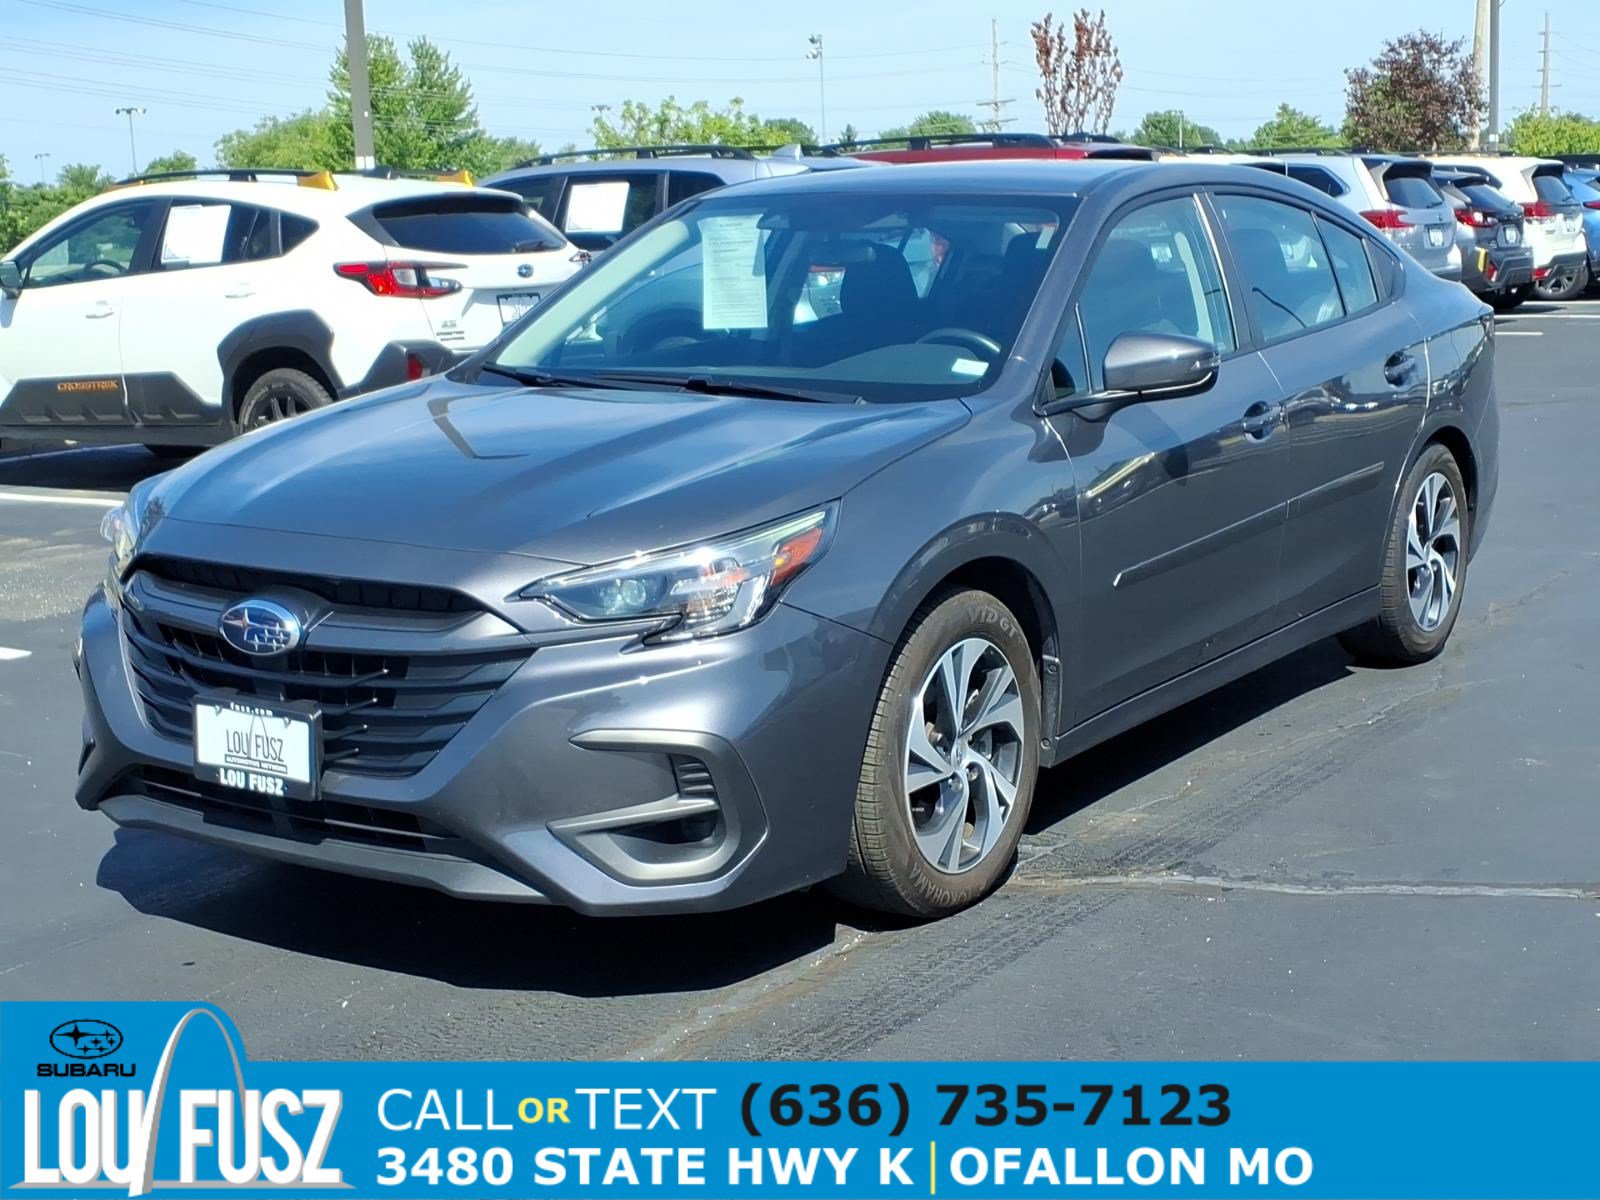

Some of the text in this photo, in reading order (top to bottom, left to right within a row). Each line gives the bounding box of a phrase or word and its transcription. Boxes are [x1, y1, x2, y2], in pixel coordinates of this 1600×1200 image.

[226, 729, 285, 763] LOU FUSZ
[220, 768, 284, 796] LOU FUSZ
